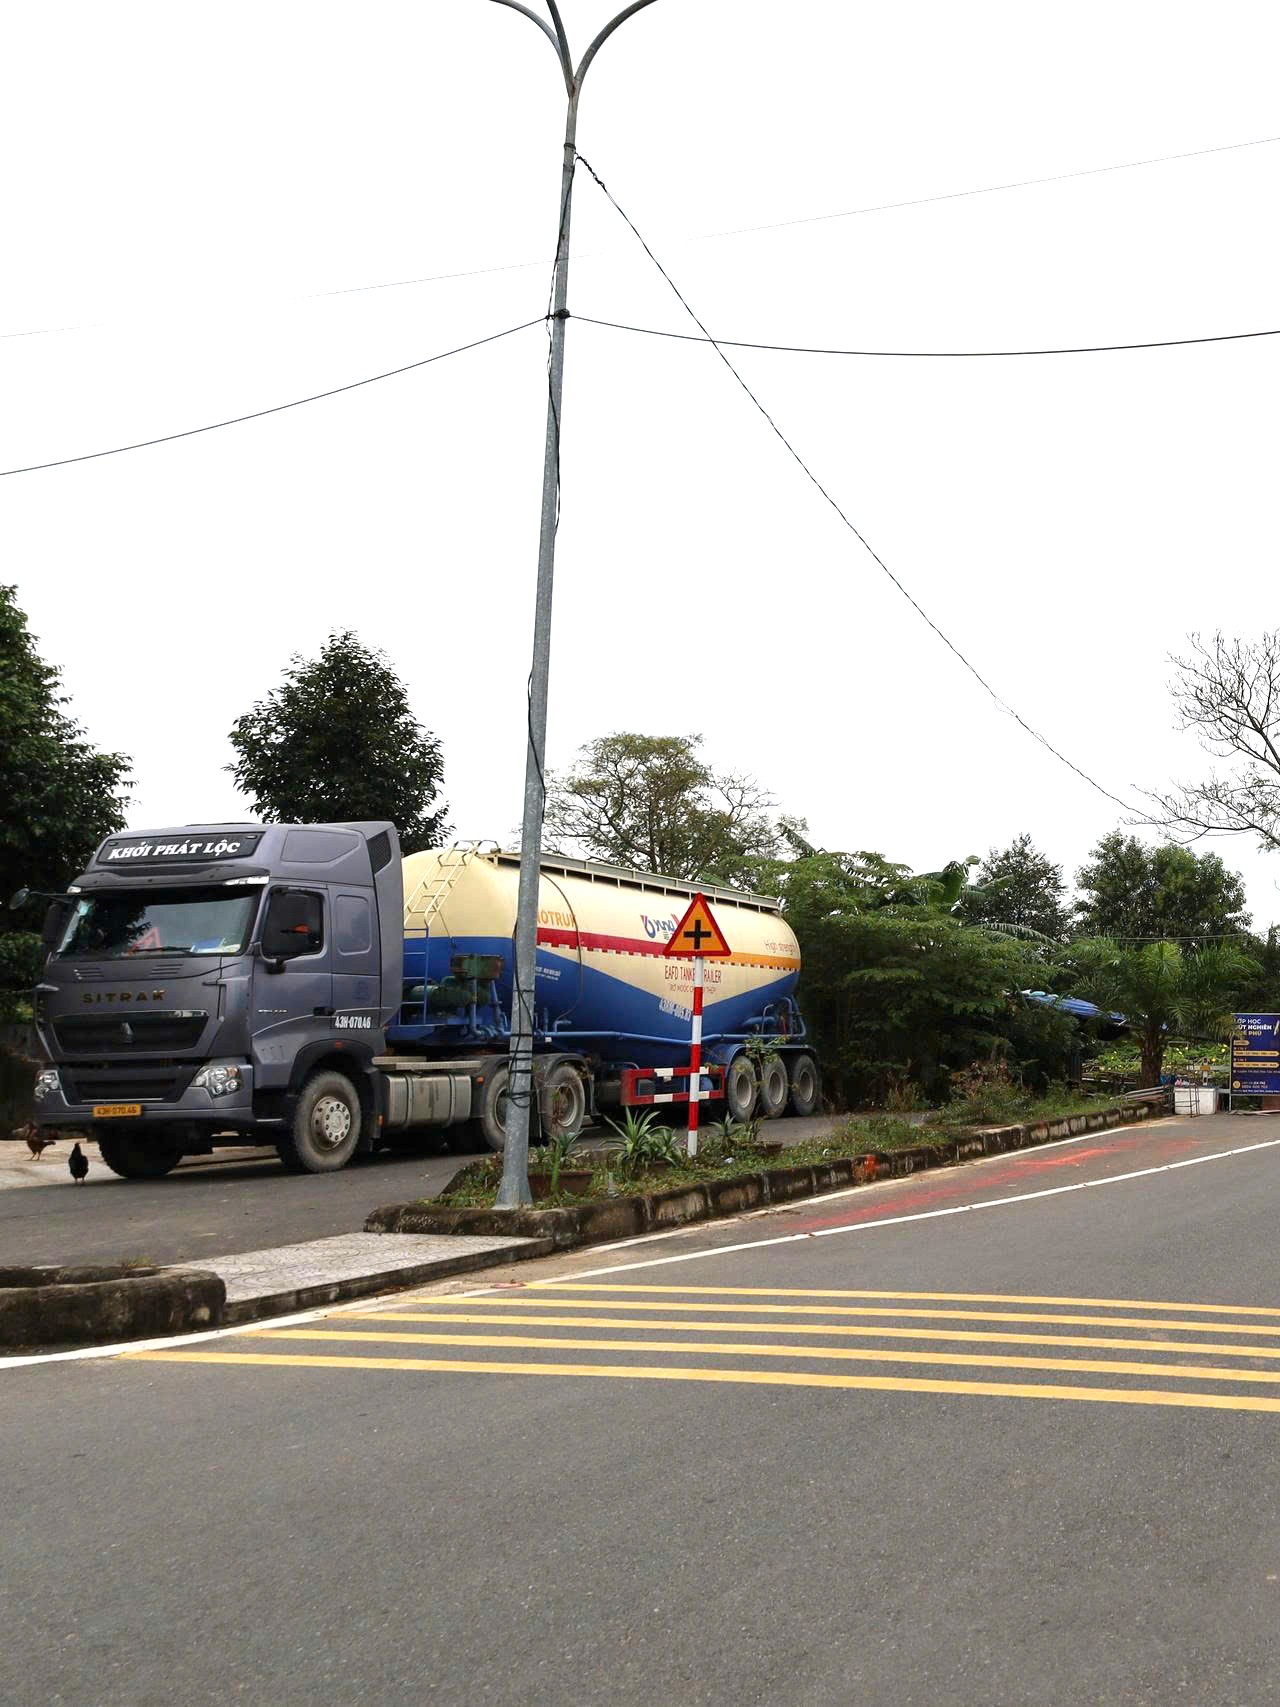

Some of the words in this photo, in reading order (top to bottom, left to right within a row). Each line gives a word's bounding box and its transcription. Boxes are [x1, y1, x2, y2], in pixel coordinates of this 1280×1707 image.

[107, 841, 153, 860] KHỞI
[151, 839, 203, 856] PHÁT
[203, 839, 241, 857] LỘC
[680, 967, 696, 981] TANKE
[703, 969, 722, 983] RAILER
[82, 990, 166, 1003] SITRAK
